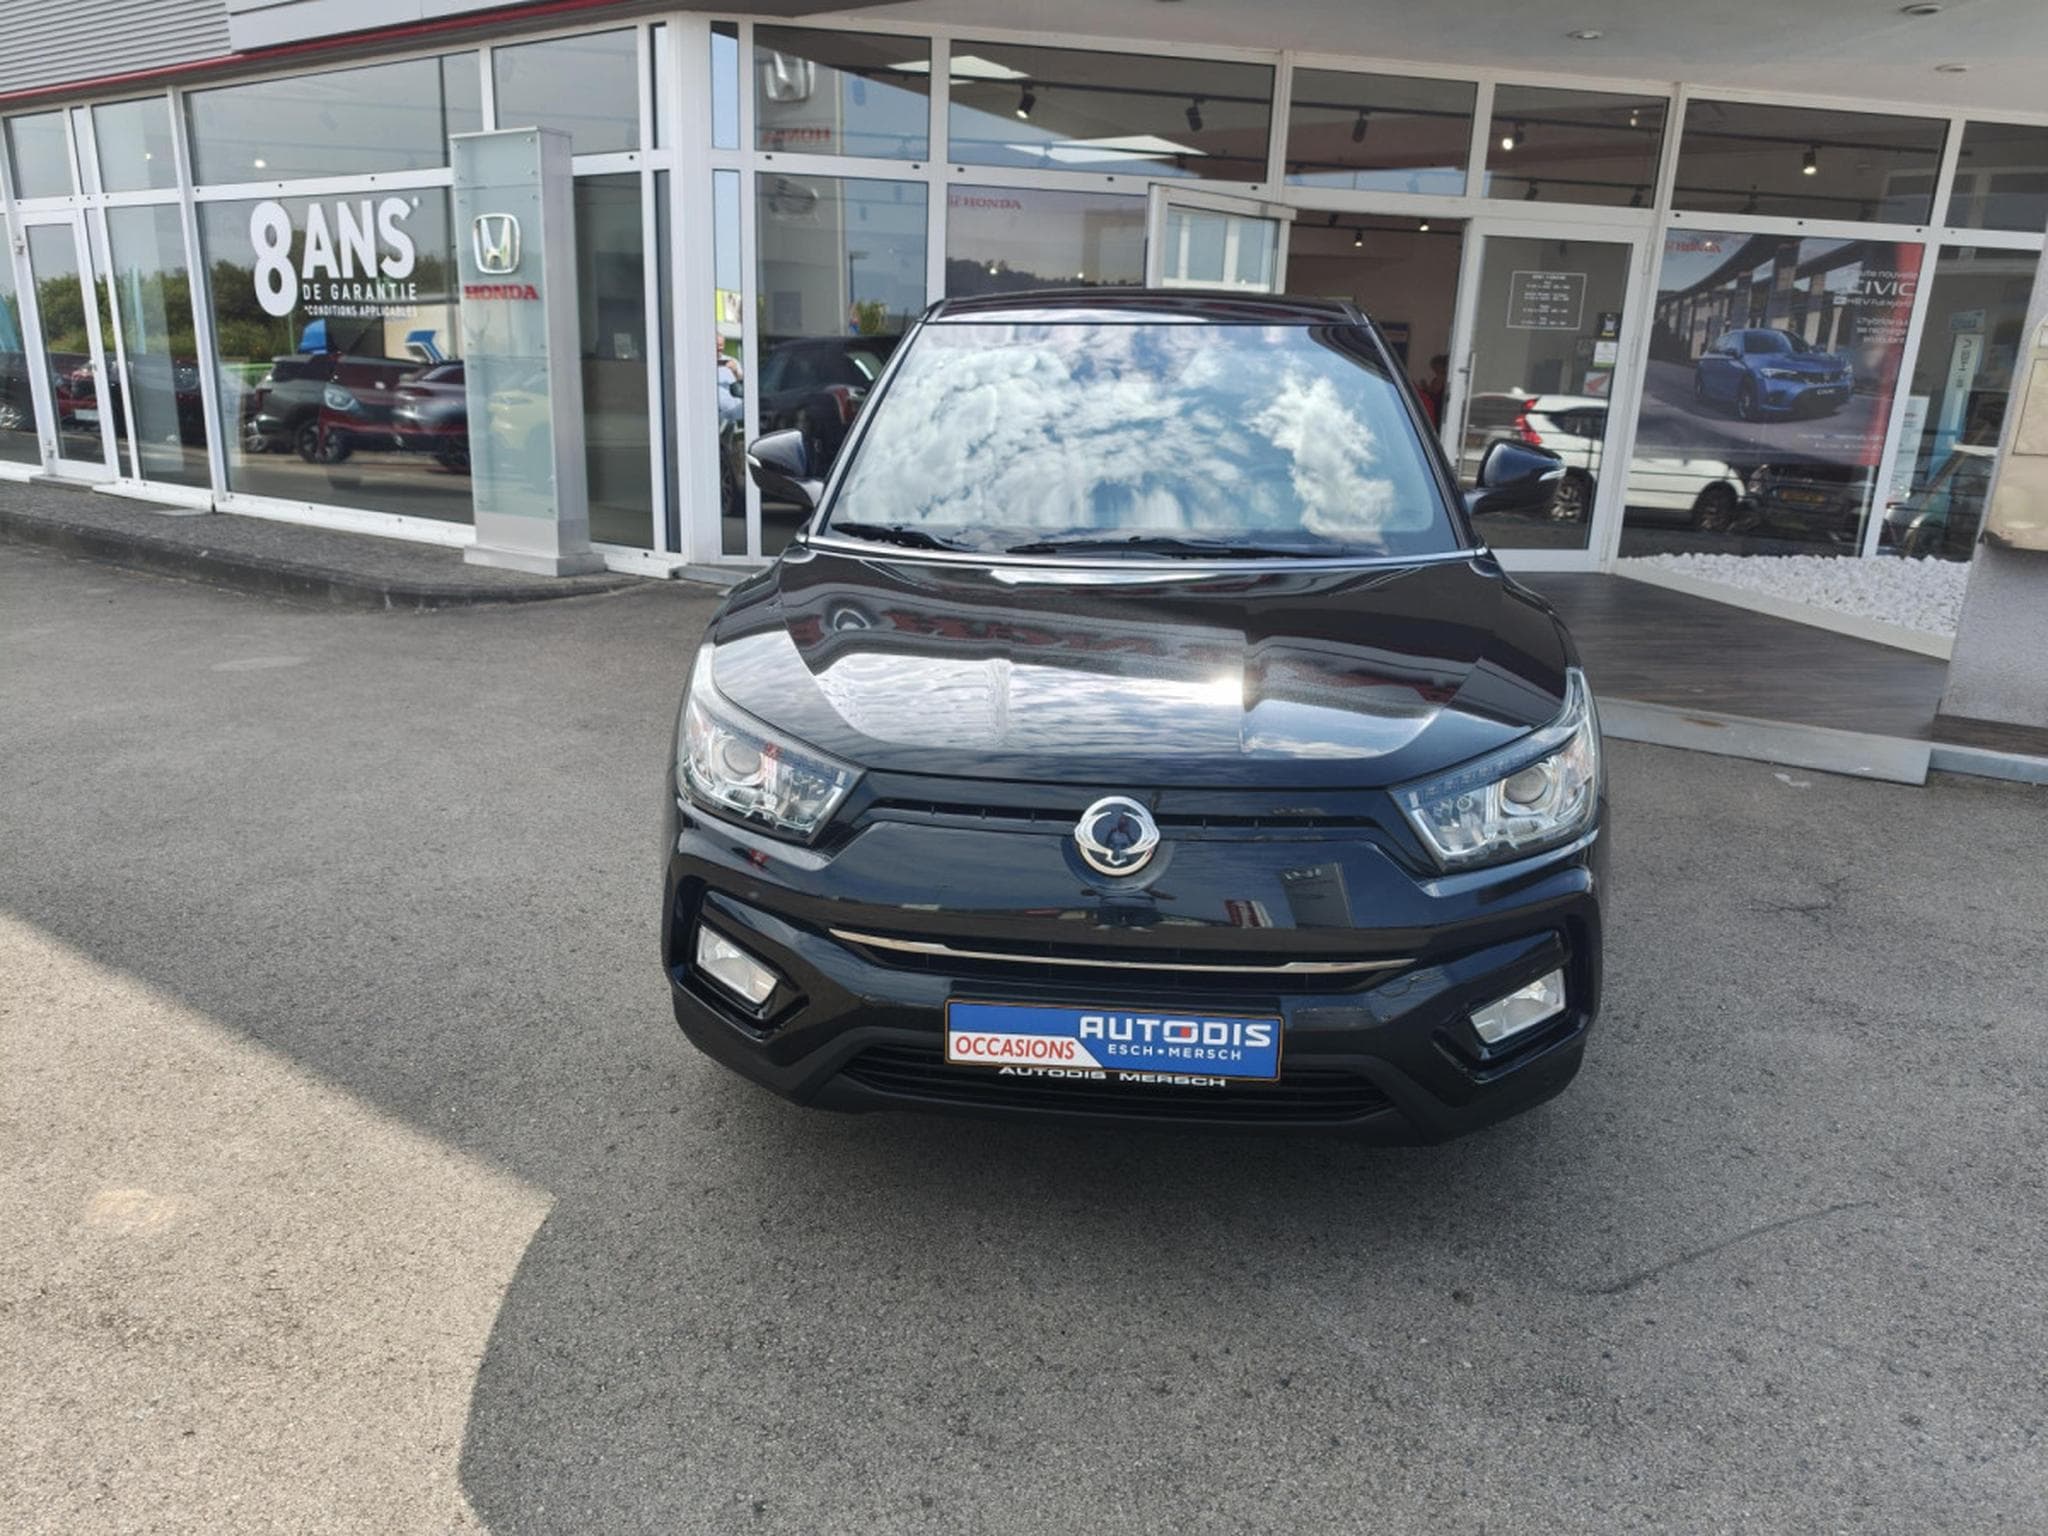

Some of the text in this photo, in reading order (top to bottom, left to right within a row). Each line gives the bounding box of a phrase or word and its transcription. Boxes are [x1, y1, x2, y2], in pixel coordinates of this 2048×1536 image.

[251, 201, 298, 316] 8
[303, 283, 417, 301] DE GARANTIE
[464, 284, 539, 300] HONDA
[1079, 1015, 1272, 1048] AUTODIS
[955, 1035, 1076, 1060] OCCASIONS
[999, 1066, 1226, 1087] AUTODIS MERSCH
